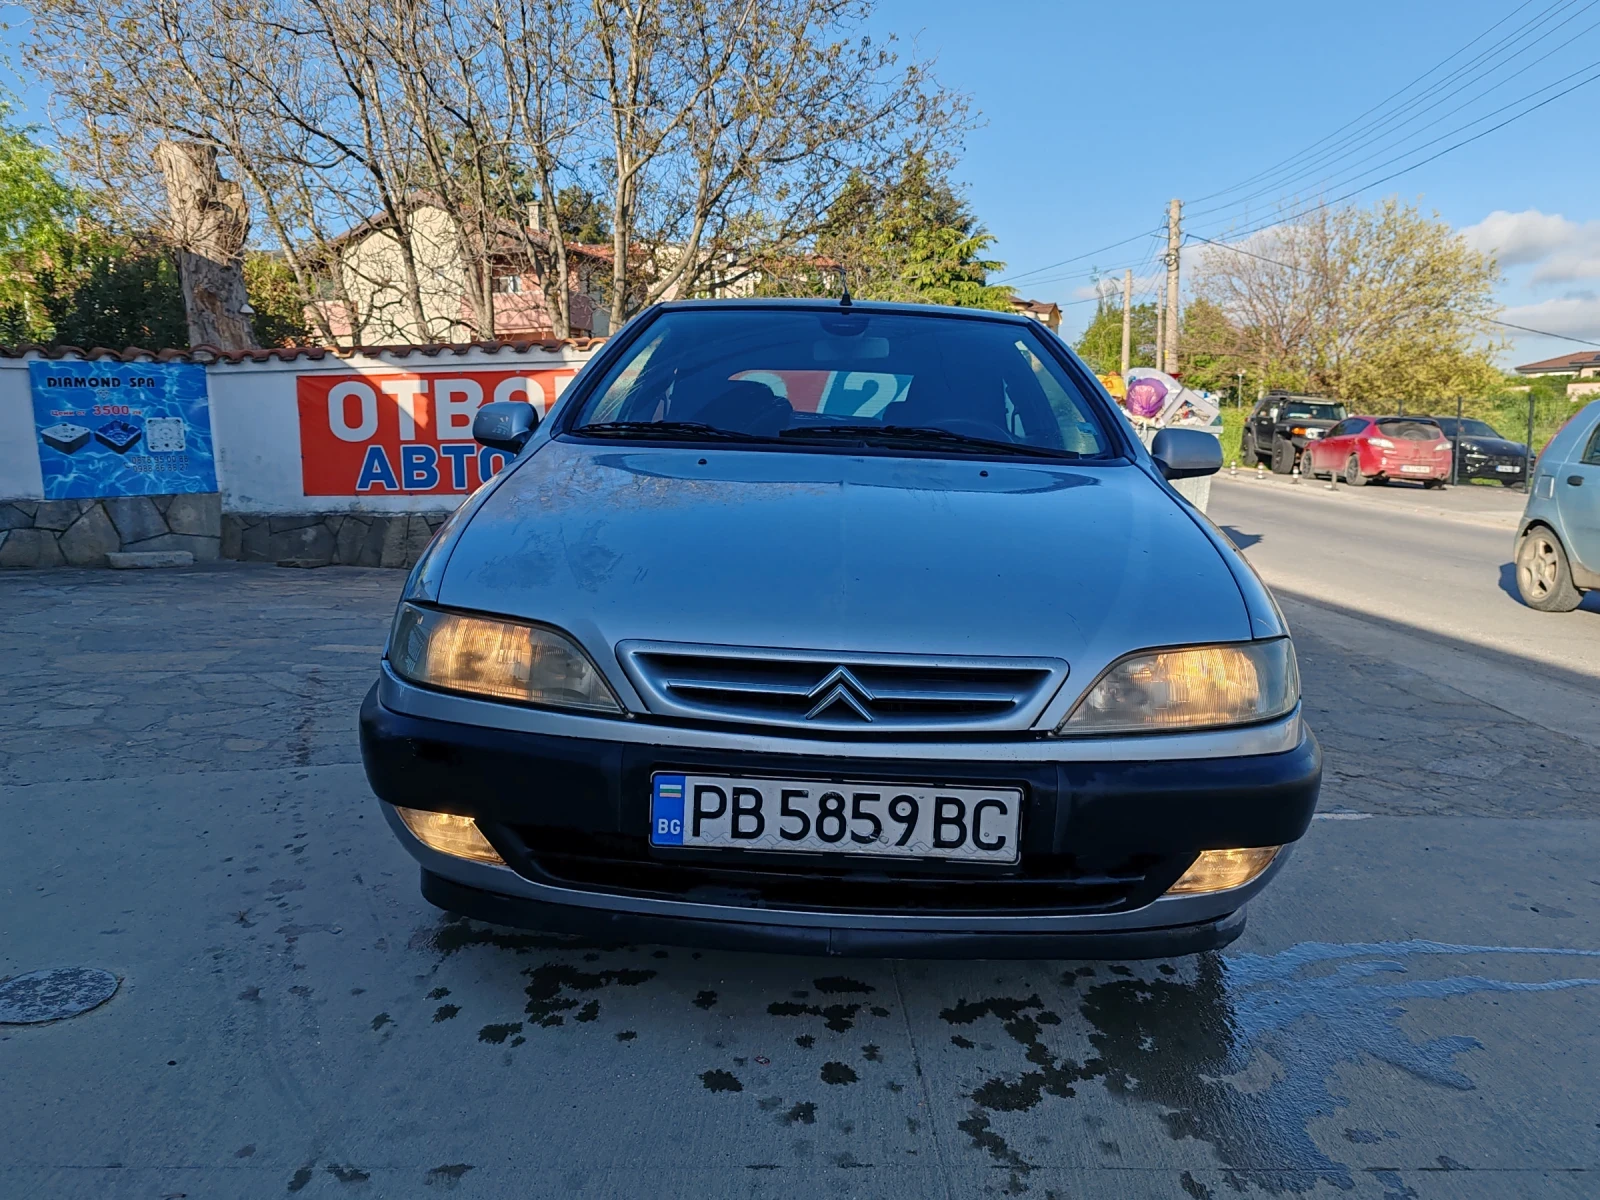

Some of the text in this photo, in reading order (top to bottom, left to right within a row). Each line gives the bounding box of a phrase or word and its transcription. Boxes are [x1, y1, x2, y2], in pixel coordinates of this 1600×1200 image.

[47, 377, 155, 388] DIAMOND SPA
[93, 405, 130, 416] 3500
[692, 784, 1008, 851] PB 5859 BC
[657, 818, 681, 835] BG
